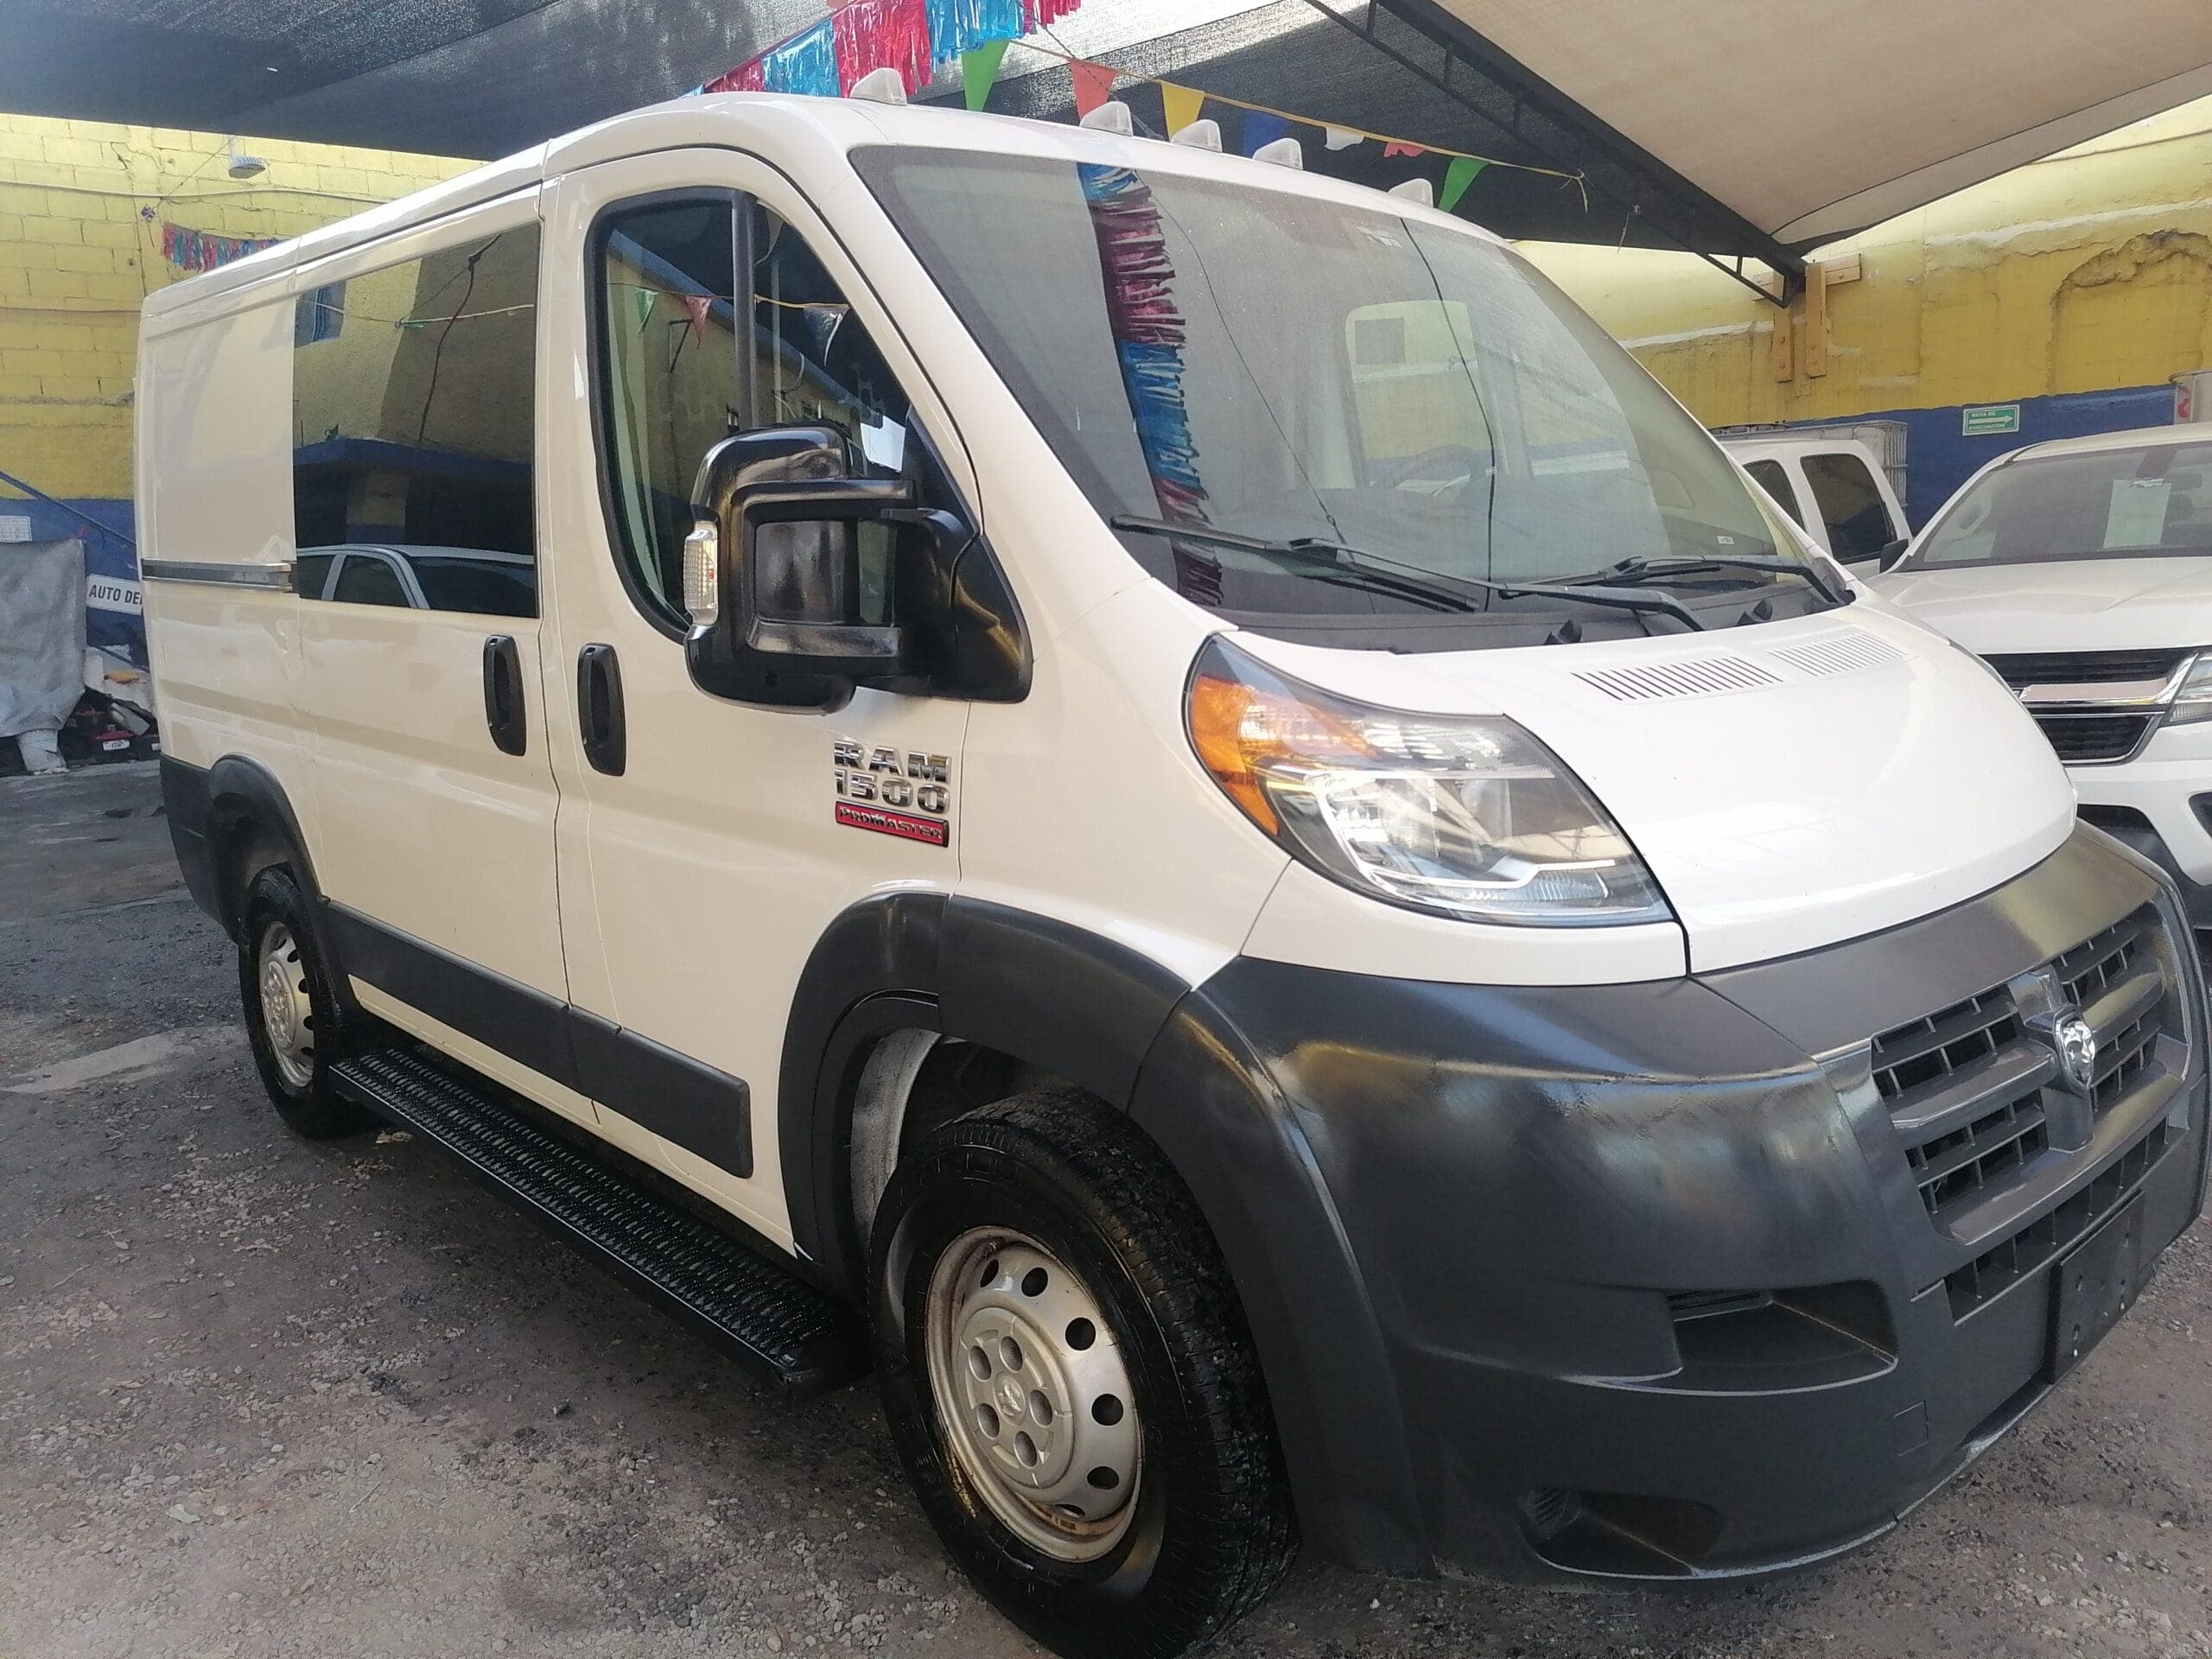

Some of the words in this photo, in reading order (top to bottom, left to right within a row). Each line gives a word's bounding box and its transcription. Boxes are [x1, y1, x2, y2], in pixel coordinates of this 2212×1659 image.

[89, 584, 121, 601] AUTO
[834, 740, 951, 784] RAM
[834, 768, 950, 814] 1500
[838, 805, 942, 839] PROMASTER
